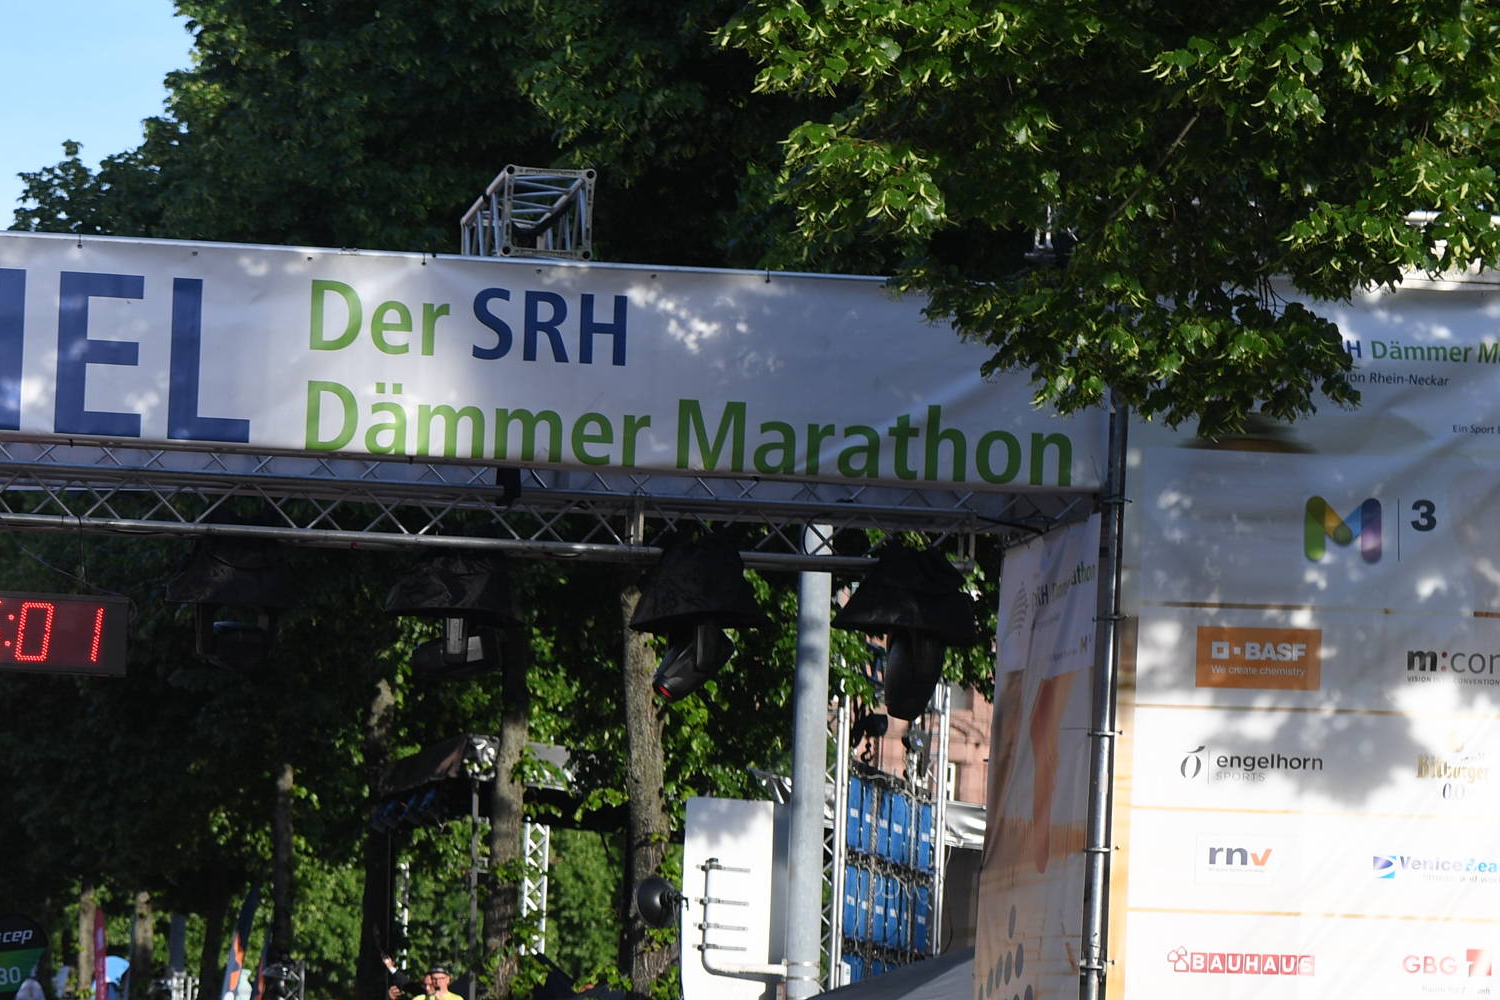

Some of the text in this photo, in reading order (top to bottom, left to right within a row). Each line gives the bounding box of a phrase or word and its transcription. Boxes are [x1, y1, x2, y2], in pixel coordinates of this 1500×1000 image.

[309, 279, 628, 366] Der SRH
[1371, 340, 1473, 362] Dämmer
[1478, 343, 1500, 363] M
[1369, 372, 1450, 386] Rhein-Neckar
[304, 379, 1074, 488] Dämmer Marathon
[1411, 500, 1437, 531] 3
[1245, 641, 1307, 662] BASF
[1228, 665, 1257, 674] create
[1259, 665, 1305, 677] chemistry
[1216, 753, 1323, 772] engelhorn
[1216, 771, 1266, 782] SPORTS
[1209, 847, 1273, 866] rnv
[2, 929, 34, 945] cep
[1190, 952, 1315, 976] BAUHAUS
[1402, 954, 1458, 975] GBG
